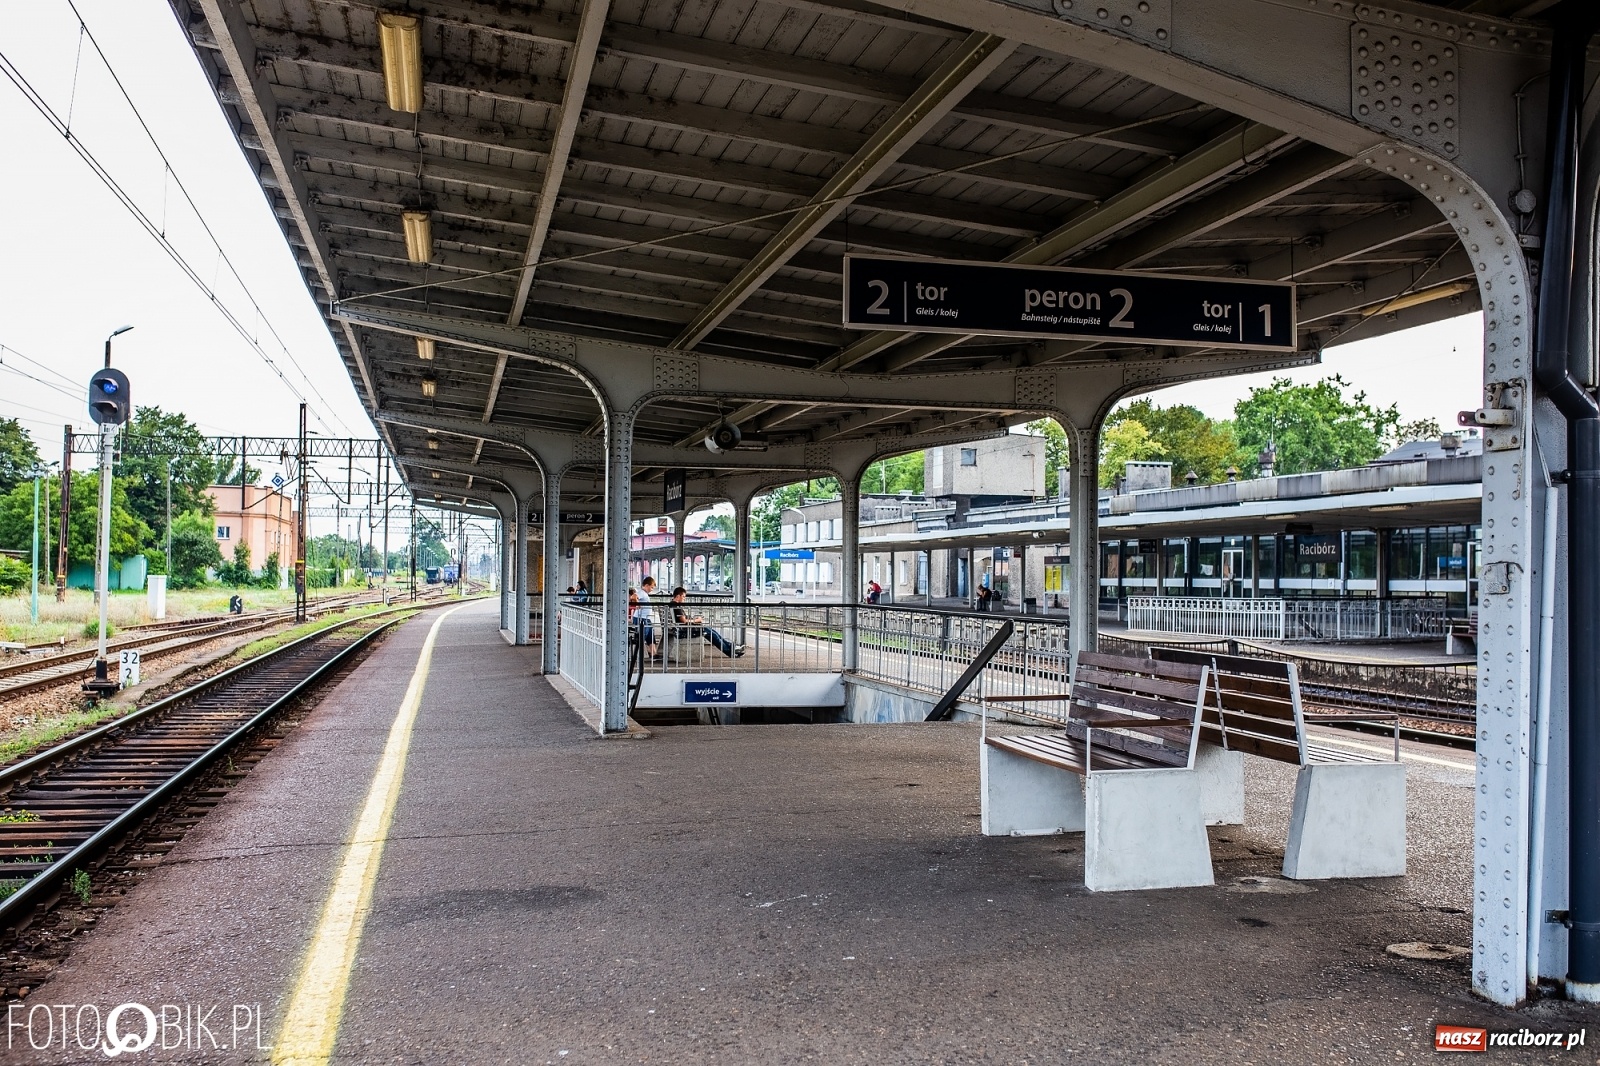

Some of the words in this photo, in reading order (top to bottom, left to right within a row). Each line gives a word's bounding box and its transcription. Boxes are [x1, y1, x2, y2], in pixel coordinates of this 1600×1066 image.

[867, 279, 890, 315] 2
[916, 282, 948, 301] tor
[916, 307, 935, 316] Gleis
[940, 308, 959, 319] kolej
[1024, 288, 1101, 312] peron
[1108, 288, 1135, 329] 2
[1021, 313, 1058, 324] Bahnsteig
[1063, 315, 1101, 326] nástupiště
[1202, 300, 1232, 318] tor
[1258, 303, 1272, 337] 1
[1193, 323, 1210, 332] Gleis
[1214, 324, 1232, 334] kolej
[586, 512, 593, 523] 2
[1299, 542, 1336, 555] Racibórz
[122, 651, 138, 664] 32
[125, 667, 132, 679] 2
[694, 687, 720, 697] wyjście
